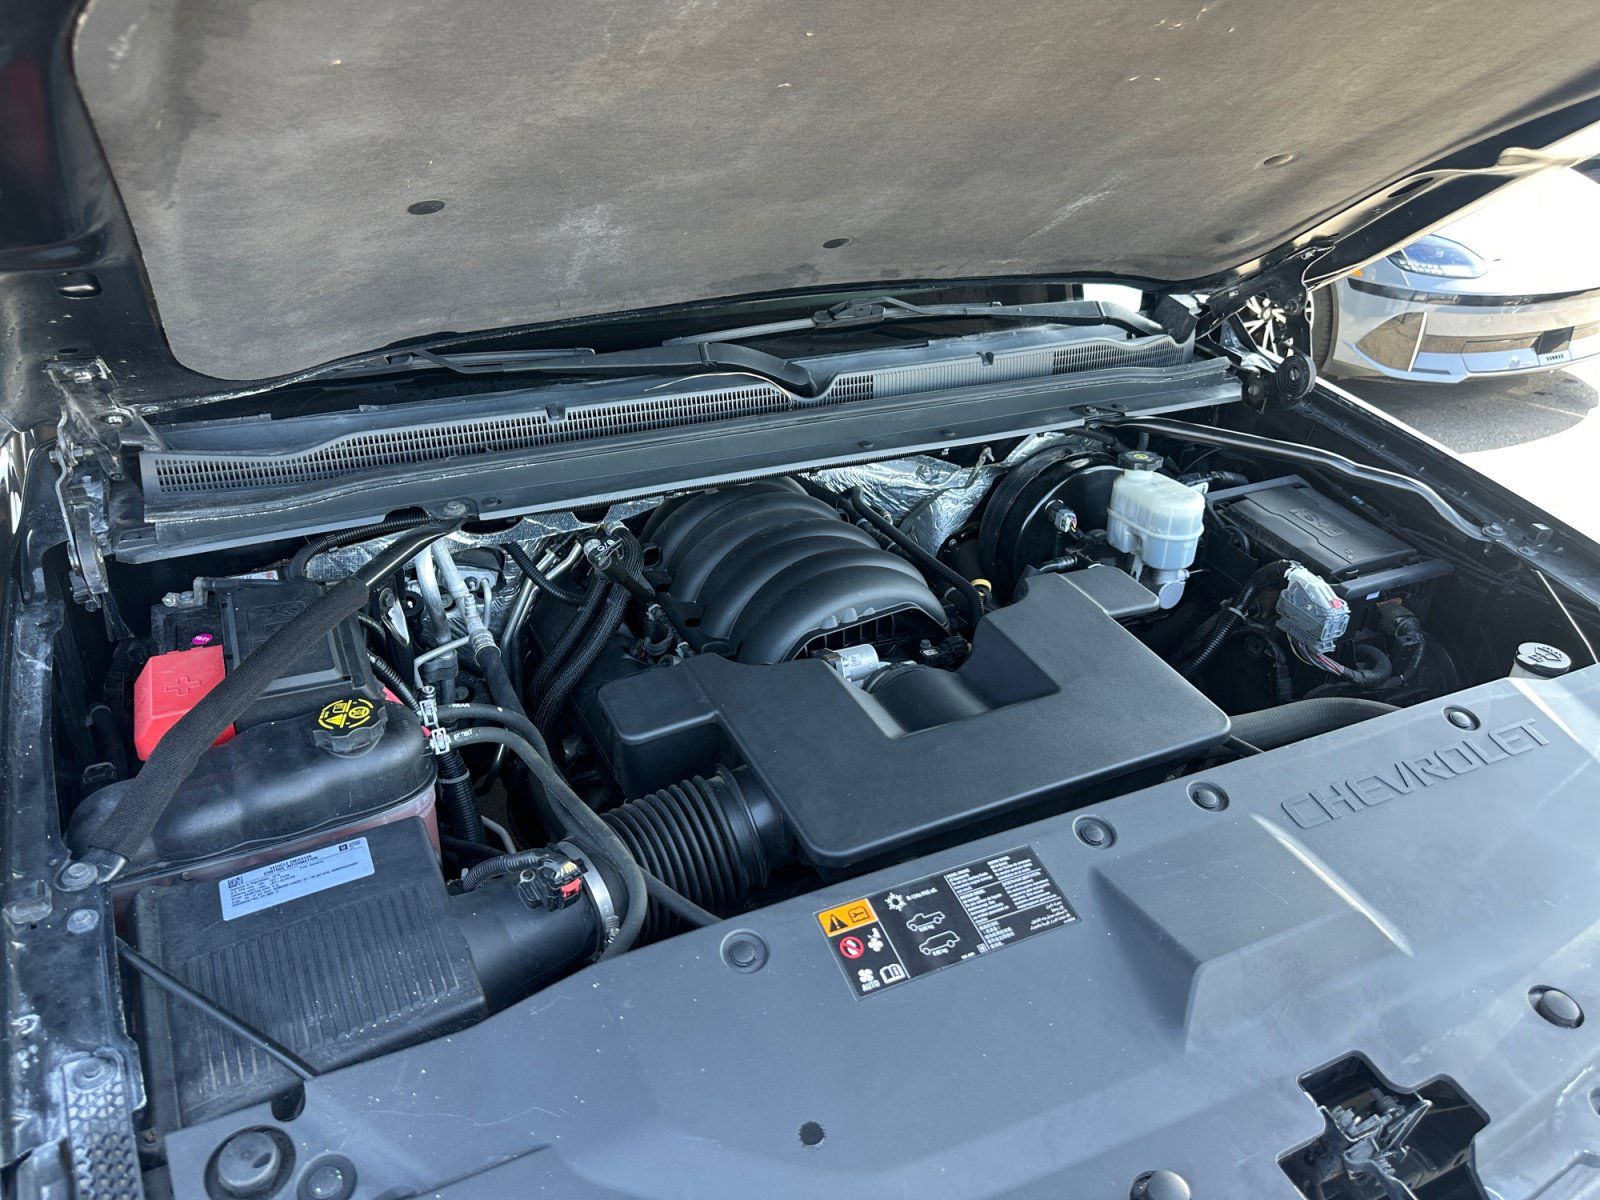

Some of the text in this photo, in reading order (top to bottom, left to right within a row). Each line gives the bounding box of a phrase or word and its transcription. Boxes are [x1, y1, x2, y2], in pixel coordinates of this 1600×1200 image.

[453, 728, 472, 740] FRONT
[1281, 718, 1550, 830] CHEVROLET
[263, 856, 319, 876] CONTROL INFORMATION
[269, 862, 290, 871] VEHICLE
[861, 980, 881, 992] AUTO
